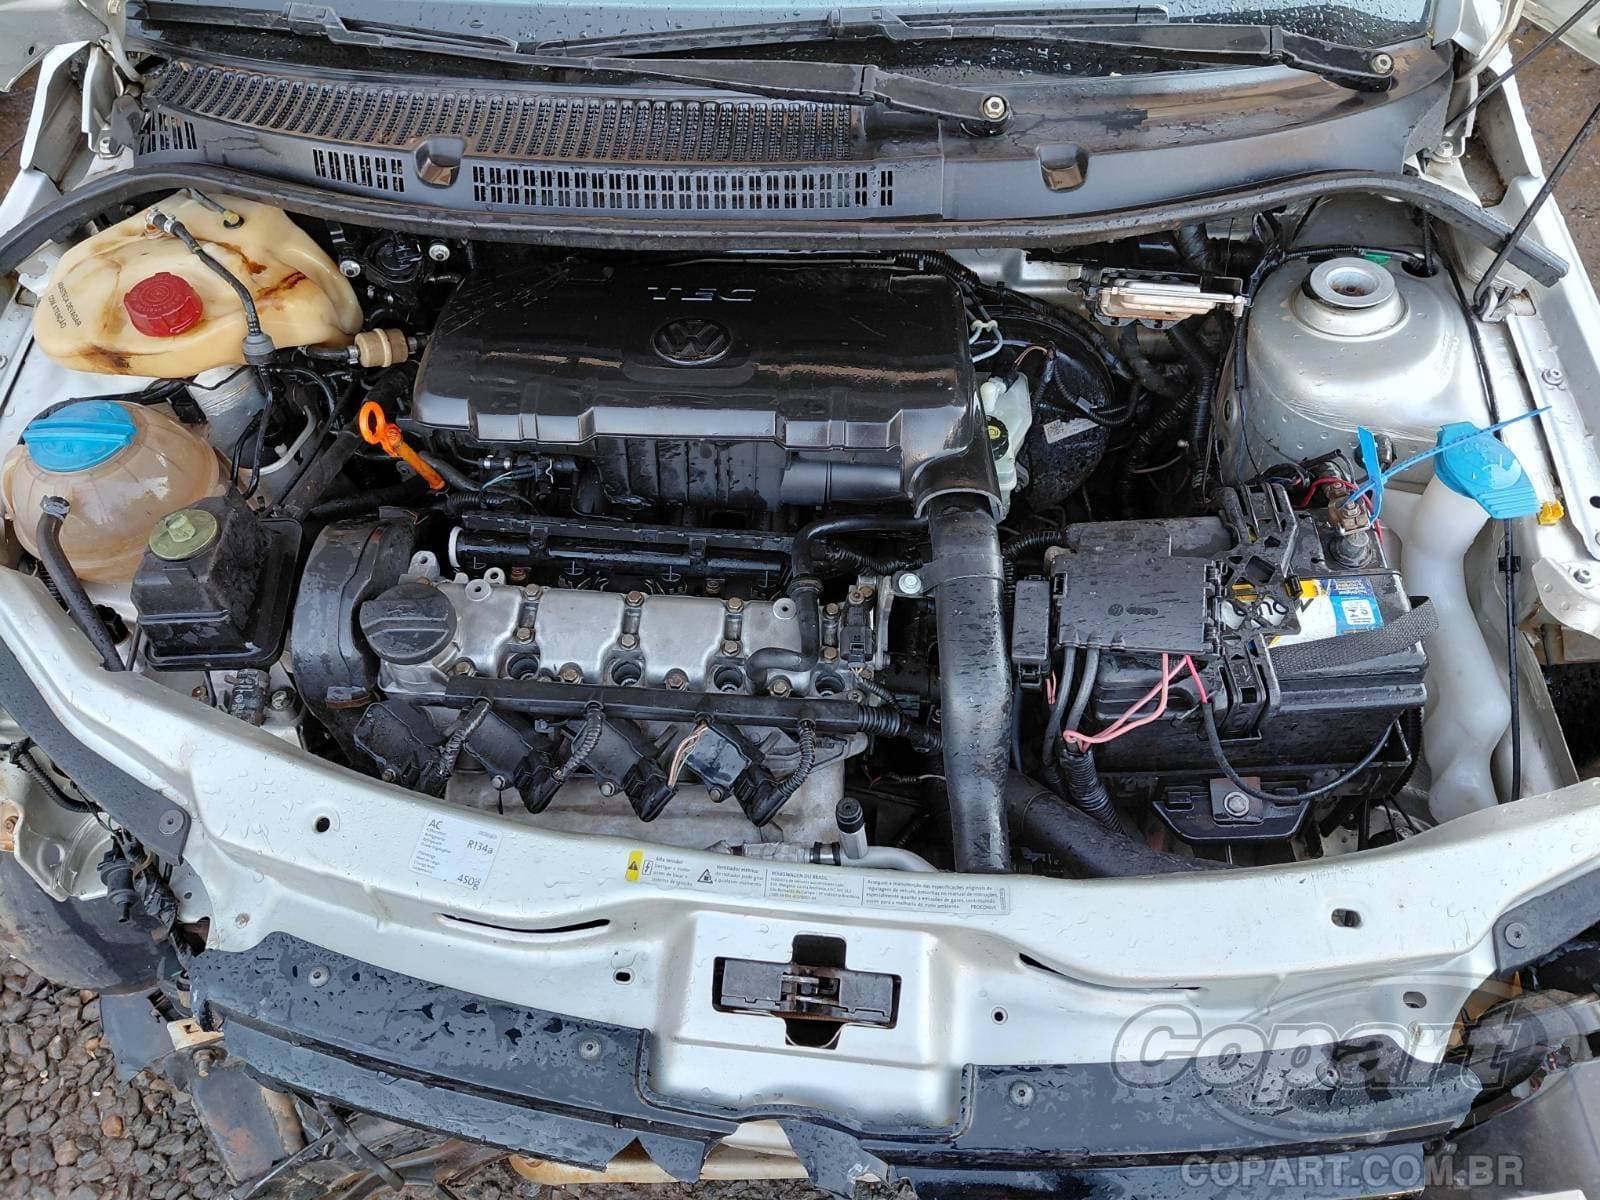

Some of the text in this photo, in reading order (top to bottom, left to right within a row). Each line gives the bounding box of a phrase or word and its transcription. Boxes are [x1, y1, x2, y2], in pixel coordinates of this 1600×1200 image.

[428, 819, 444, 830] AC
[466, 840, 494, 854] R134a
[457, 874, 482, 891] 450g
